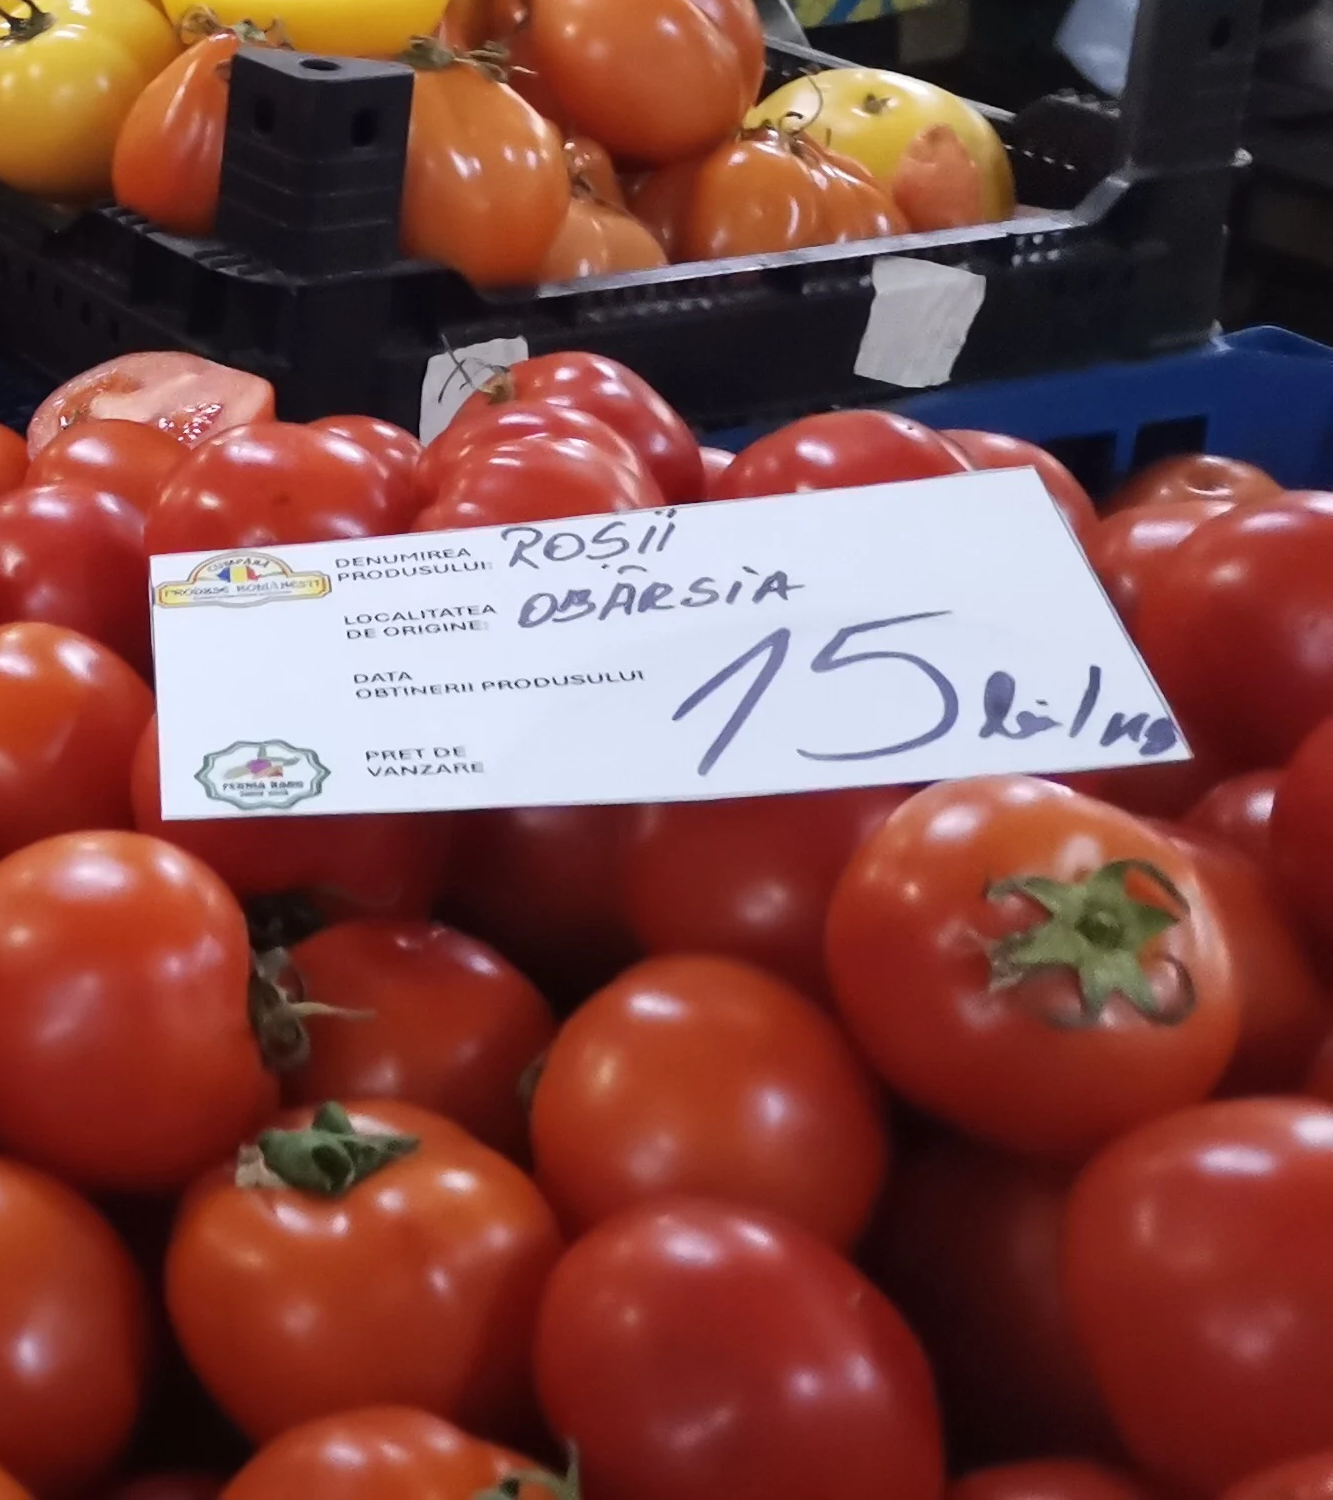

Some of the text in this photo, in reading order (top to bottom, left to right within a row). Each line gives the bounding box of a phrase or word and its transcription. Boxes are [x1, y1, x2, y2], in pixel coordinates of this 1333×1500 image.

[335, 547, 472, 569] DENUMIREA
[343, 604, 497, 626] LOCALITATEA
[346, 627, 377, 640] DE
[353, 670, 414, 685] DATA
[355, 669, 647, 700] OBTINERII PRODUSULUI
[671, 609, 960, 777] 15
[433, 745, 467, 760] DE
[367, 760, 486, 779] VANZARE
